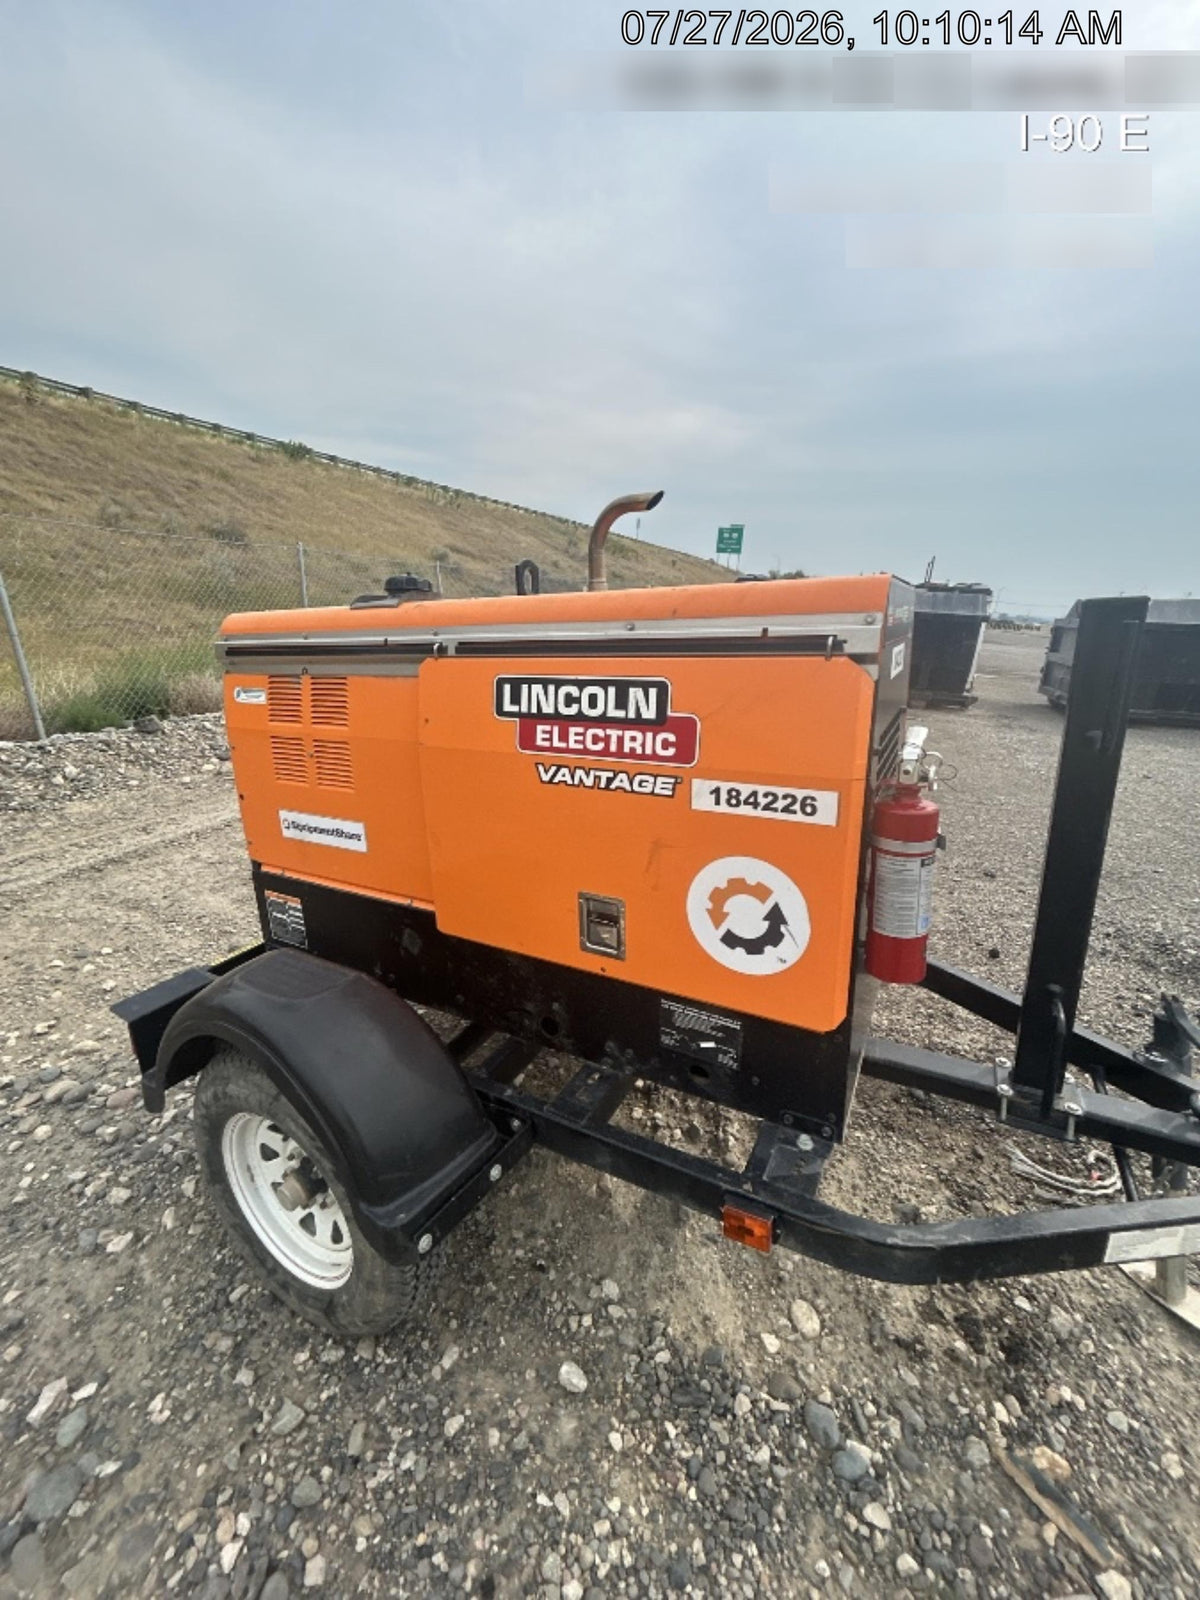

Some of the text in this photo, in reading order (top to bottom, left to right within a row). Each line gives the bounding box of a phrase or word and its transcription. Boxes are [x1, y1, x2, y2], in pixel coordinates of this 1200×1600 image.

[502, 683, 658, 720] LINCOLN
[535, 724, 677, 757] ELECTRIC
[536, 763, 679, 798] VANTAGE
[709, 785, 818, 817] 184226
